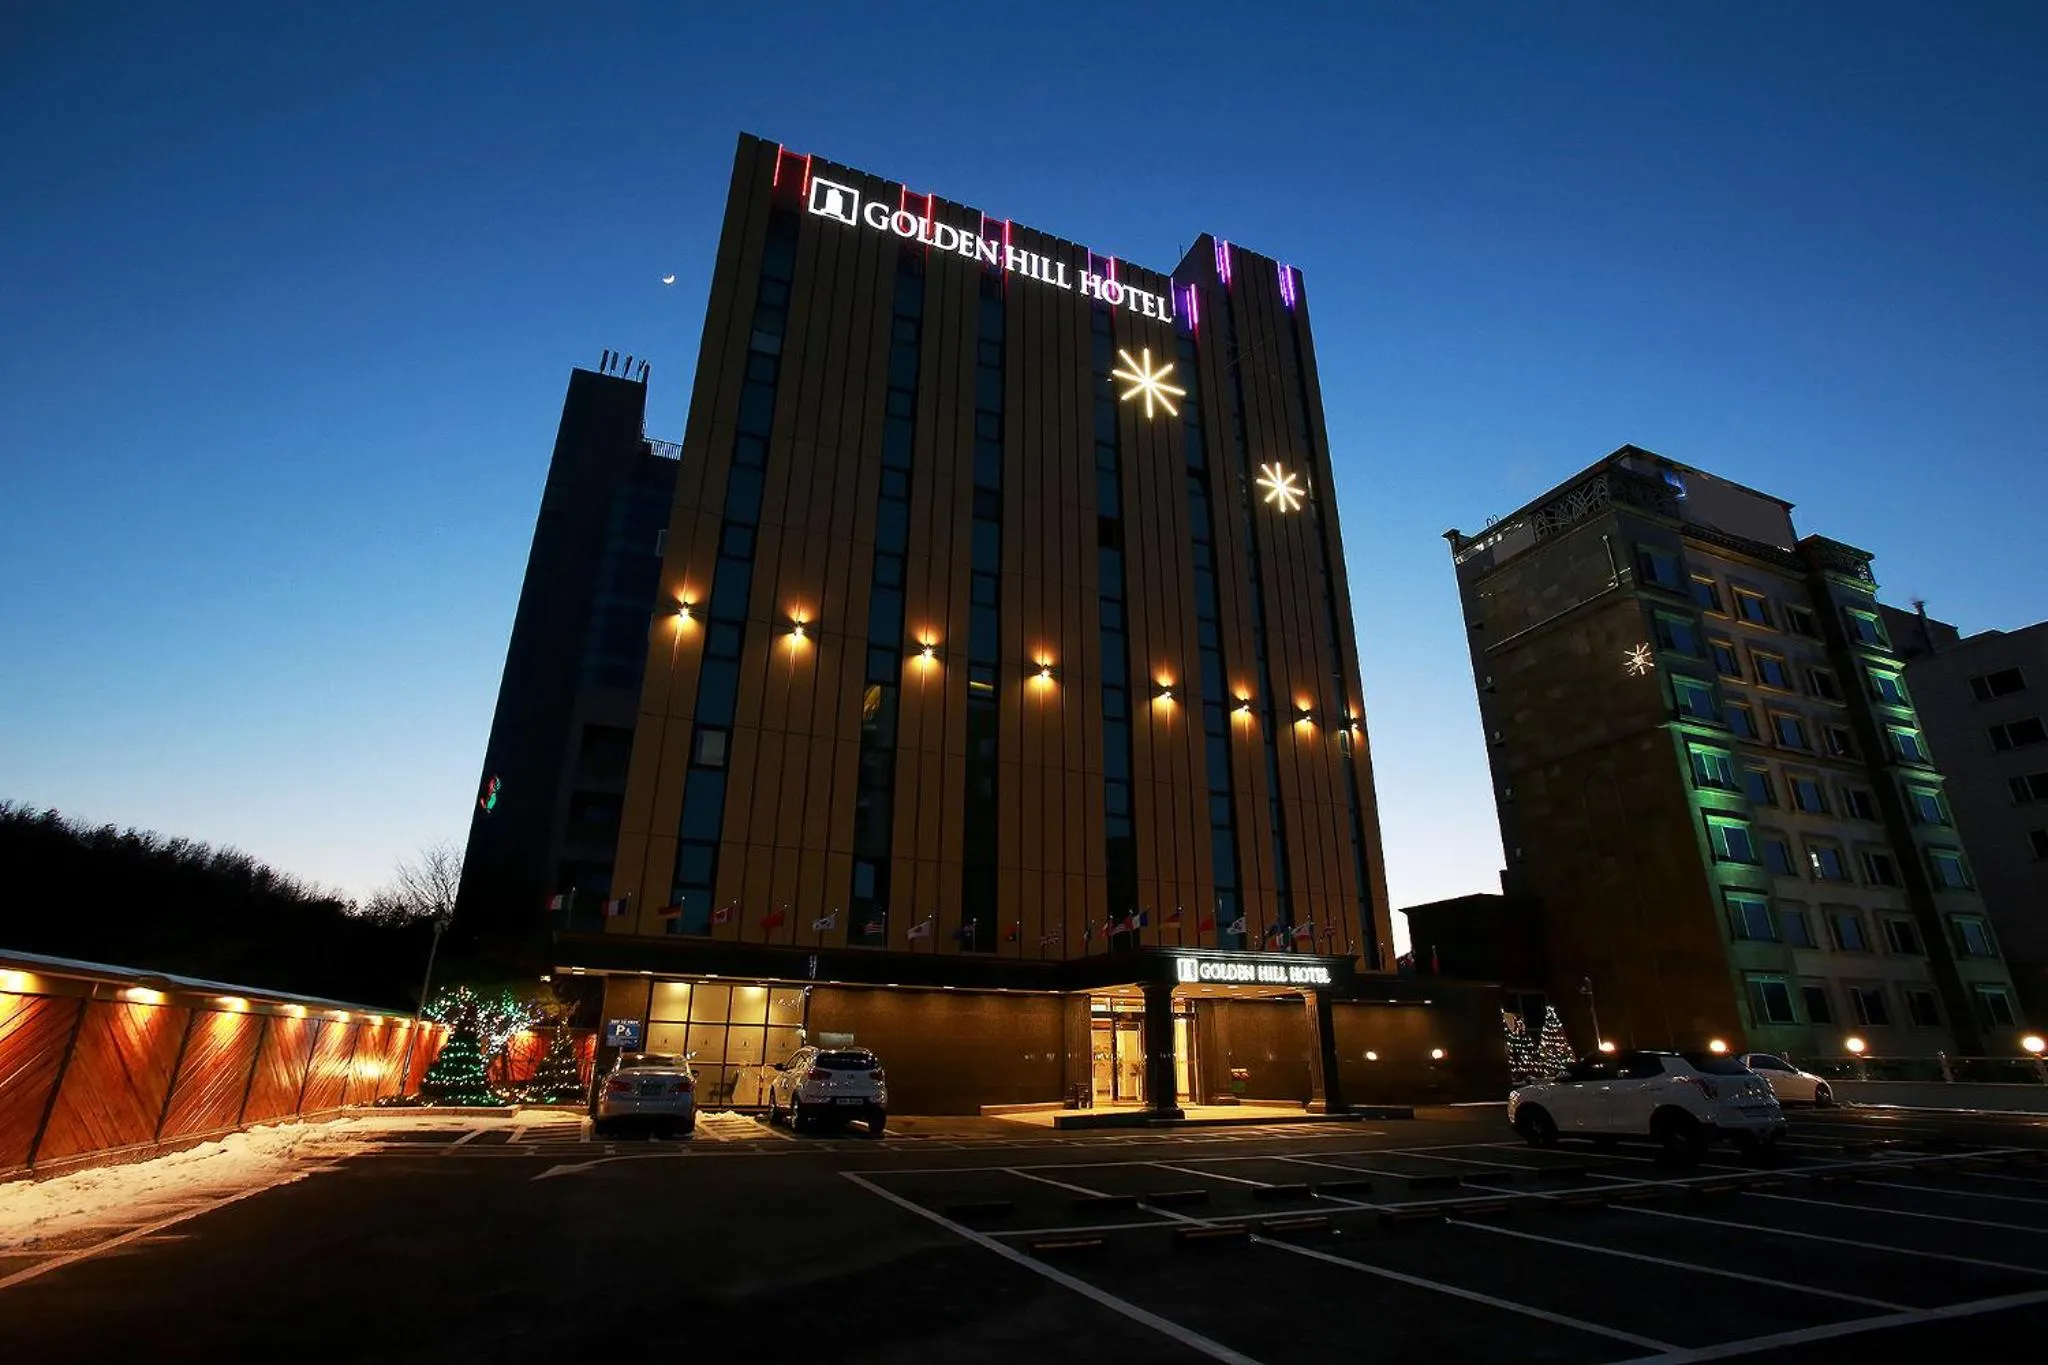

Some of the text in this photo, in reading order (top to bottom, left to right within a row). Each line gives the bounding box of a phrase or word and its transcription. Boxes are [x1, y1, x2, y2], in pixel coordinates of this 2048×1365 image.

[864, 202, 1172, 323] GOLDEN HILL HOTEL
[1200, 963, 1331, 983] GOLDEN HILL HOTEL
